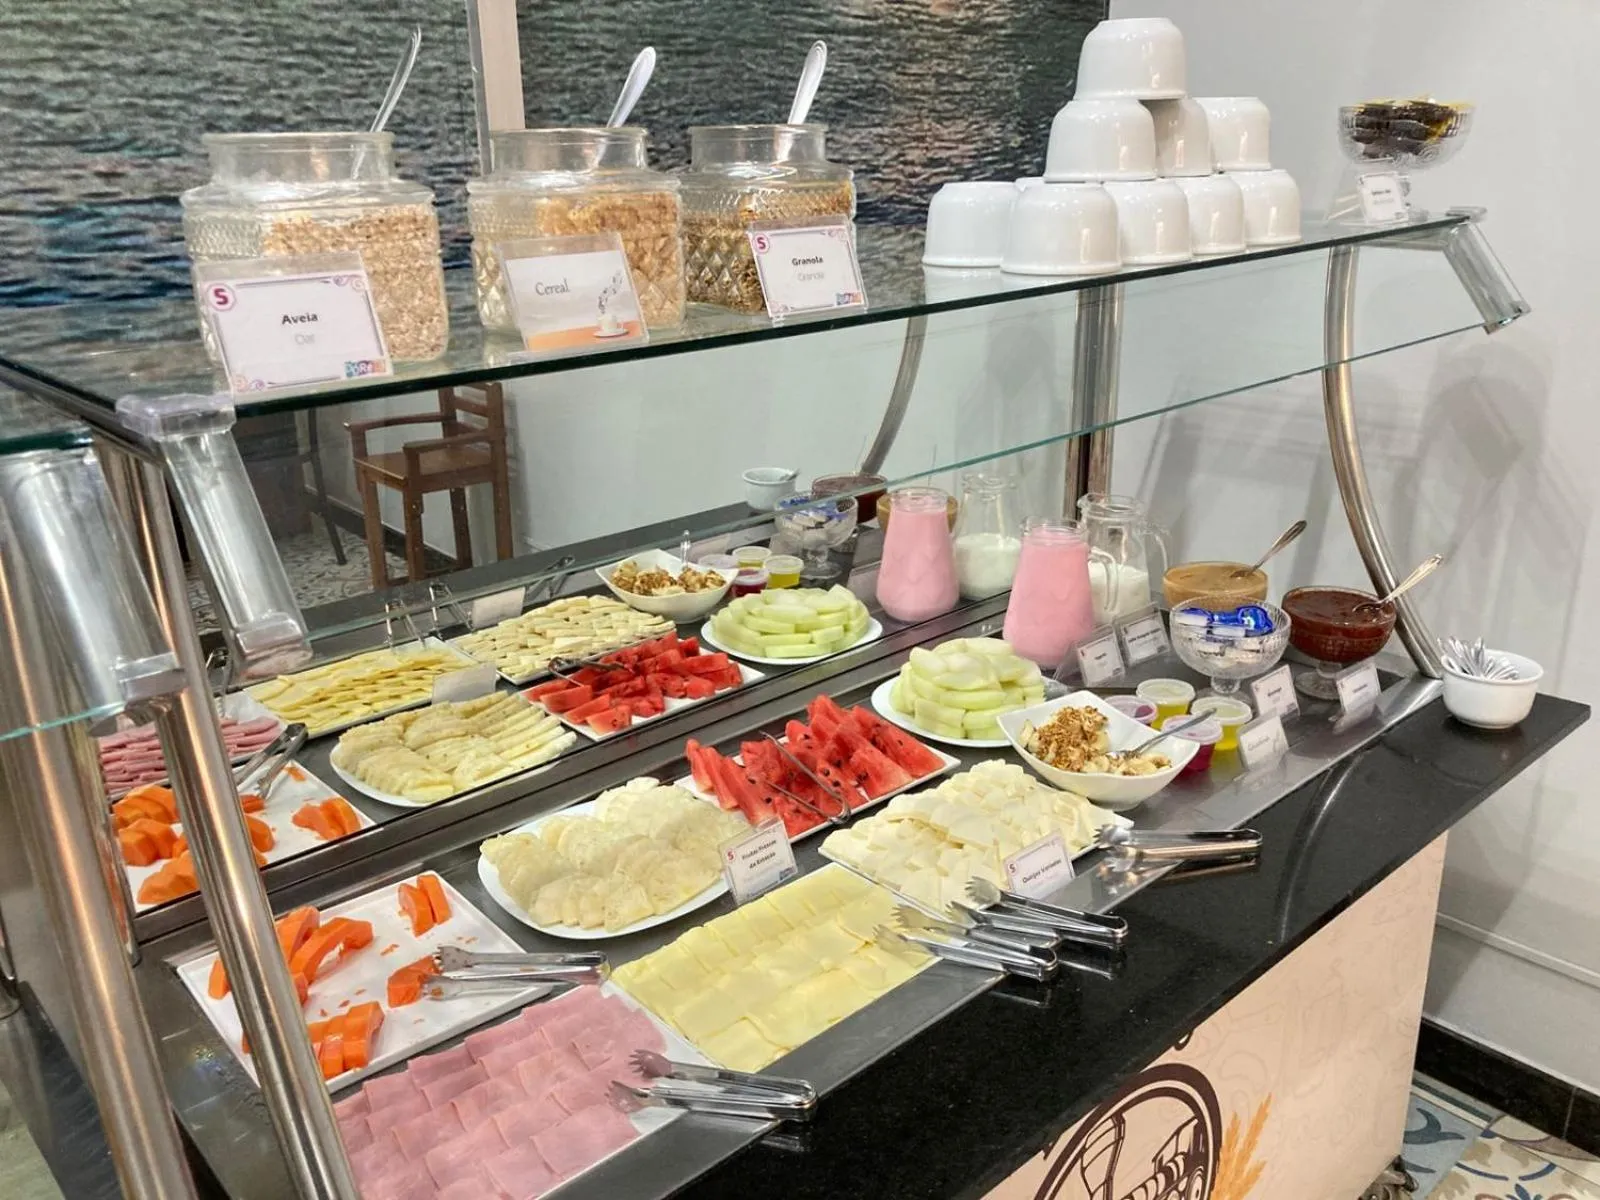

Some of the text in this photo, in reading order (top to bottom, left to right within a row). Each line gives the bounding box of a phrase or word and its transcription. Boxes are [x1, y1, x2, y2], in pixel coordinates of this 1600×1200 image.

[756, 237, 766, 250] S
[791, 255, 824, 266] Granola
[535, 278, 571, 296] Cereal
[213, 288, 229, 305] S
[281, 312, 319, 326] Aveia
